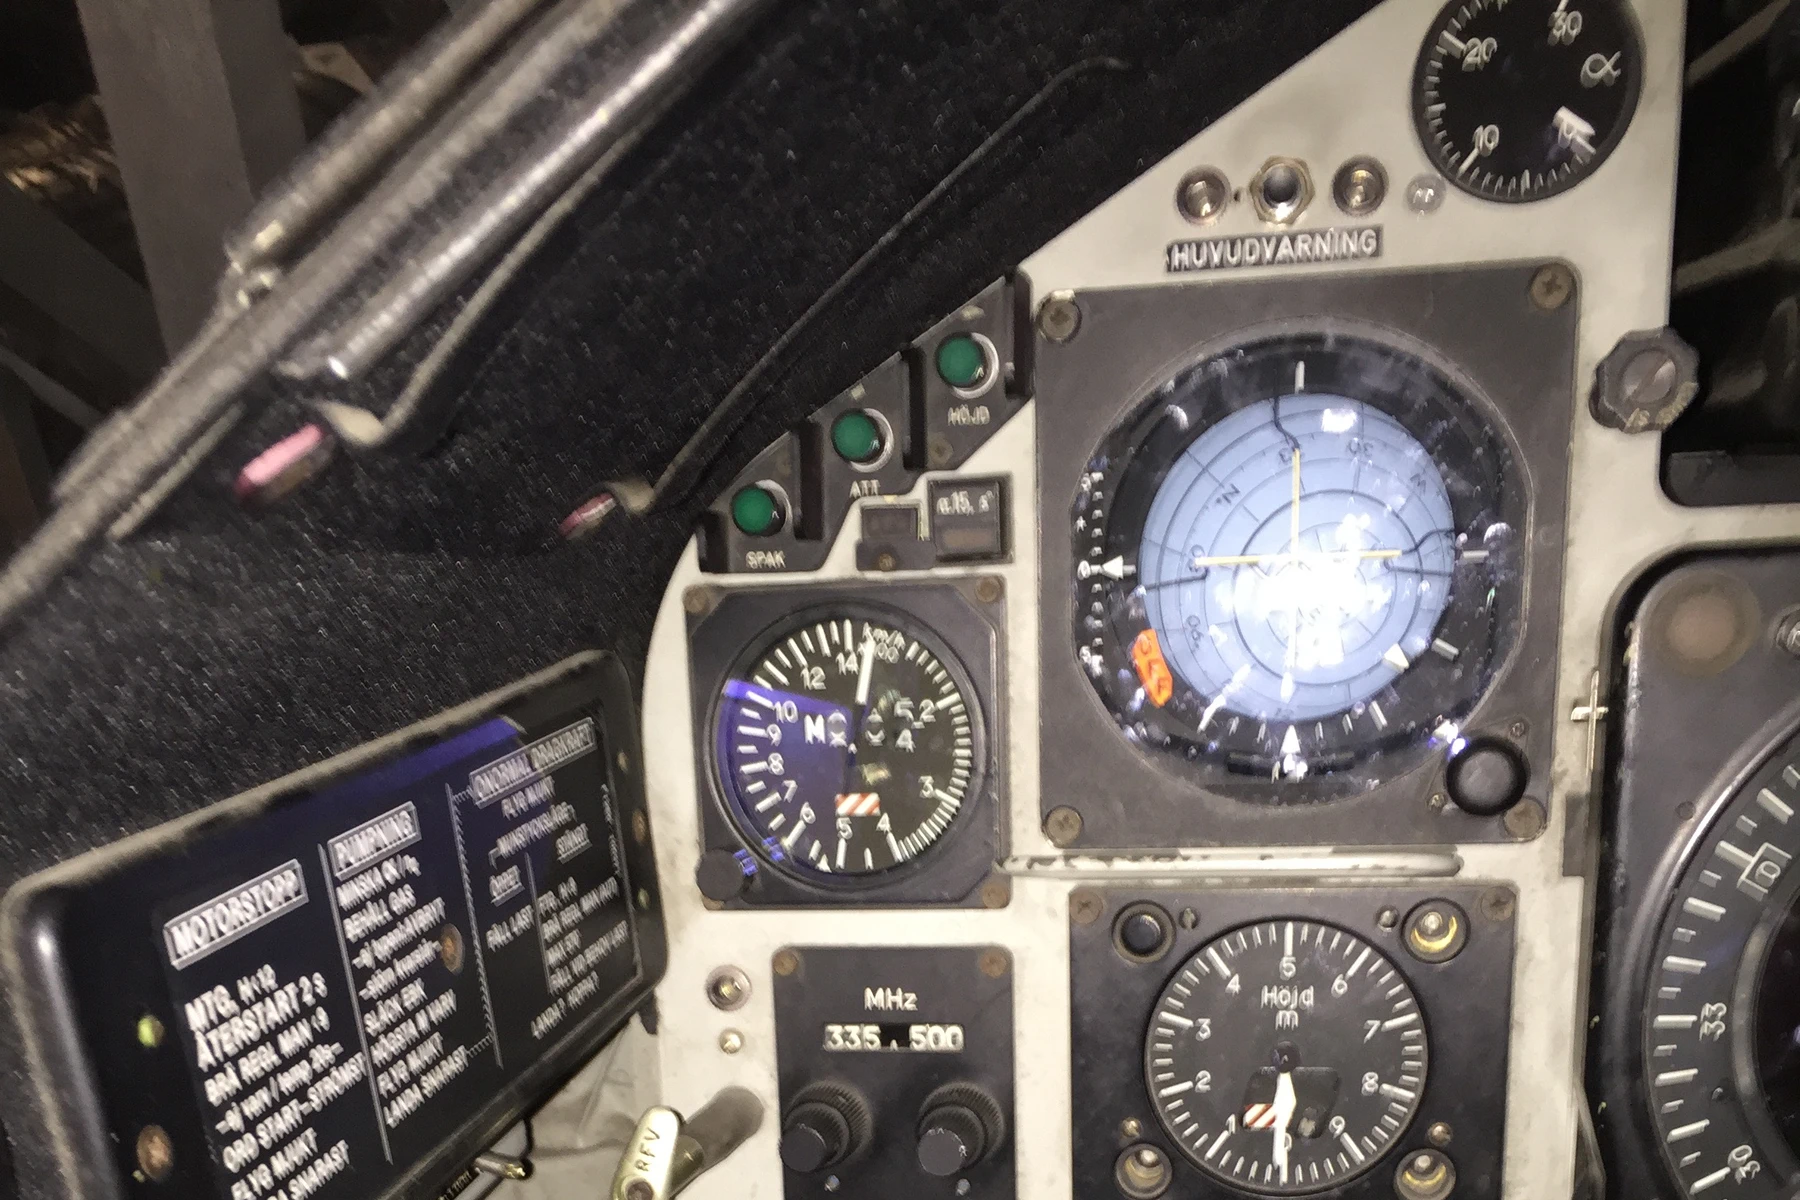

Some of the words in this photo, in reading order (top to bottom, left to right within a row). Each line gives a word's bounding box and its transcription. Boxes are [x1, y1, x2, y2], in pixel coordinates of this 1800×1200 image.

[1462, 37, 1498, 71] 20
[1473, 124, 1499, 156] 10
[1171, 228, 1378, 269] HUVUDVARNING
[850, 480, 881, 498] ATT
[746, 551, 786, 569] SPAK
[836, 652, 859, 675] 14
[801, 666, 826, 690] 12
[773, 700, 799, 723] 10
[919, 699, 936, 722] 2
[766, 724, 782, 746] 9
[804, 714, 826, 744] M
[767, 753, 785, 775] 8
[782, 779, 798, 803] 7
[918, 776, 934, 798] 3
[800, 802, 816, 824] 6
[876, 813, 891, 833] 4
[836, 818, 852, 839] 5
[388, 883, 417, 917] GAS
[172, 869, 300, 956] MOTORSTOPP
[1280, 956, 1296, 980] 5
[1225, 976, 1242, 997] 4
[1331, 974, 1348, 997] 6
[864, 987, 918, 1011] MHz
[194, 981, 302, 1072] ÅTERSTART
[1195, 1018, 1212, 1042] 3
[1275, 1009, 1299, 1031] m
[1362, 1020, 1382, 1044] 7
[276, 1016, 315, 1059] MAN
[826, 1025, 881, 1048] 335
[908, 1025, 964, 1049] 500
[377, 1058, 412, 1100] FLYG
[407, 1031, 445, 1076] MJUKT
[384, 1081, 426, 1130] LANDA
[420, 1043, 469, 1099] SNARAST
[1195, 1070, 1212, 1094] 2
[1361, 1072, 1380, 1095] 8
[1328, 1116, 1346, 1139] 9
[222, 1131, 260, 1174] ORD
[269, 1126, 319, 1182] MJUKT
